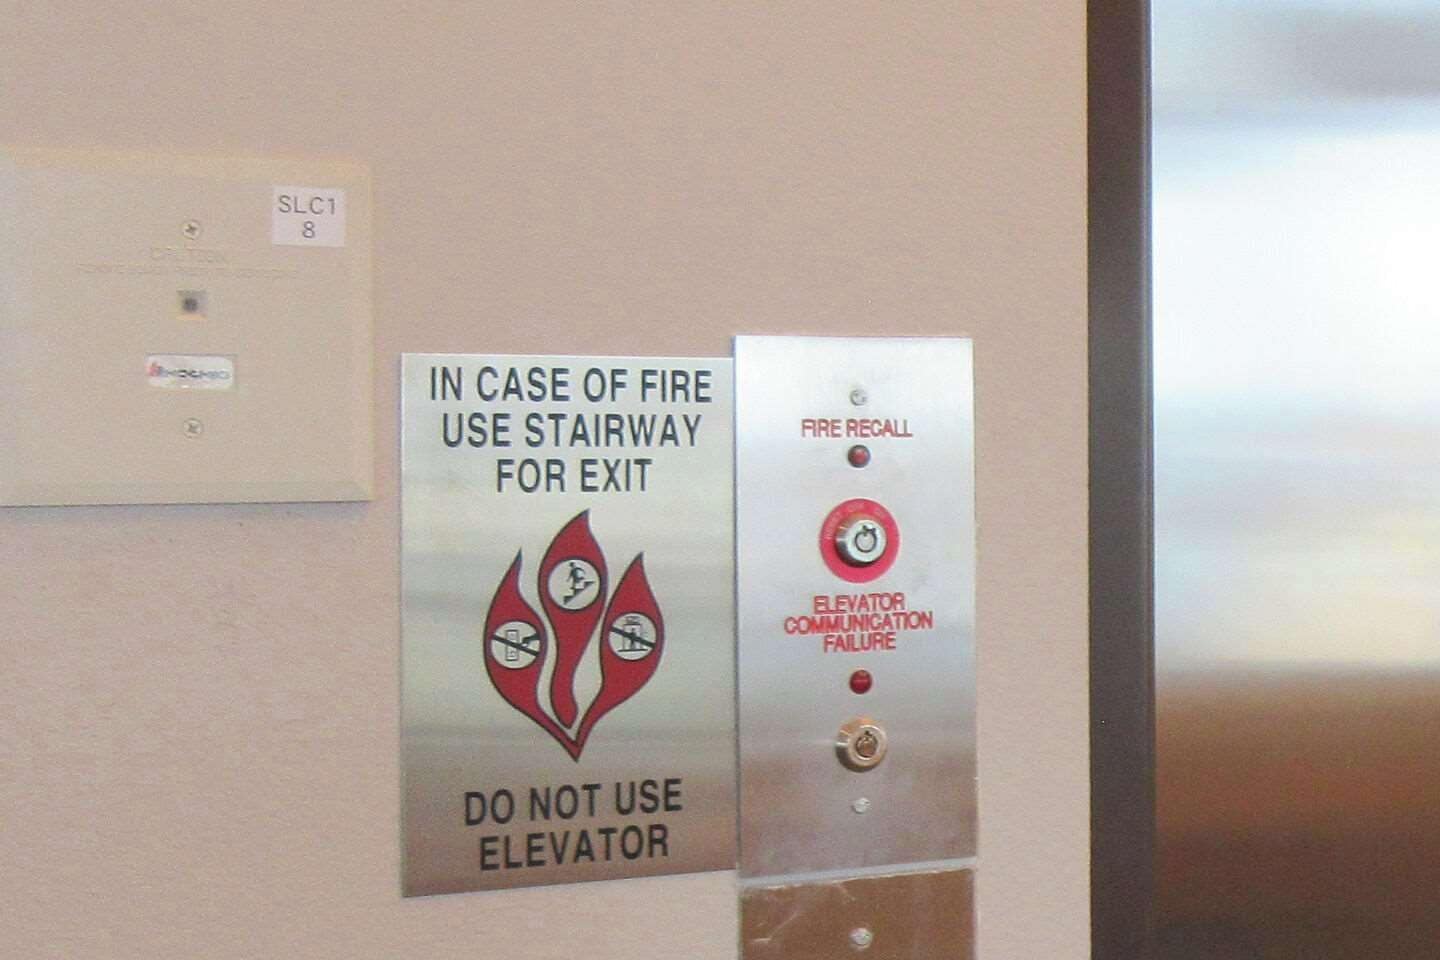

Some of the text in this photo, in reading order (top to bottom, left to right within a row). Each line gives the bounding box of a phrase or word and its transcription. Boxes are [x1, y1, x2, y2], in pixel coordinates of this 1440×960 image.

[279, 195, 335, 215] SLC1
[303, 221, 315, 238] 8
[431, 366, 712, 403] IN CASE OF FIRE
[443, 412, 702, 447] USE STAIRWAY
[802, 419, 913, 438] FIRE RECALL
[496, 458, 652, 493] FOR EXIT
[813, 593, 905, 614] ELEVATOR
[784, 611, 933, 635] COMMUNICATION
[824, 632, 896, 652] FAILURE
[464, 778, 683, 826] DO NOT USE
[480, 824, 669, 871] ELEVATOR
